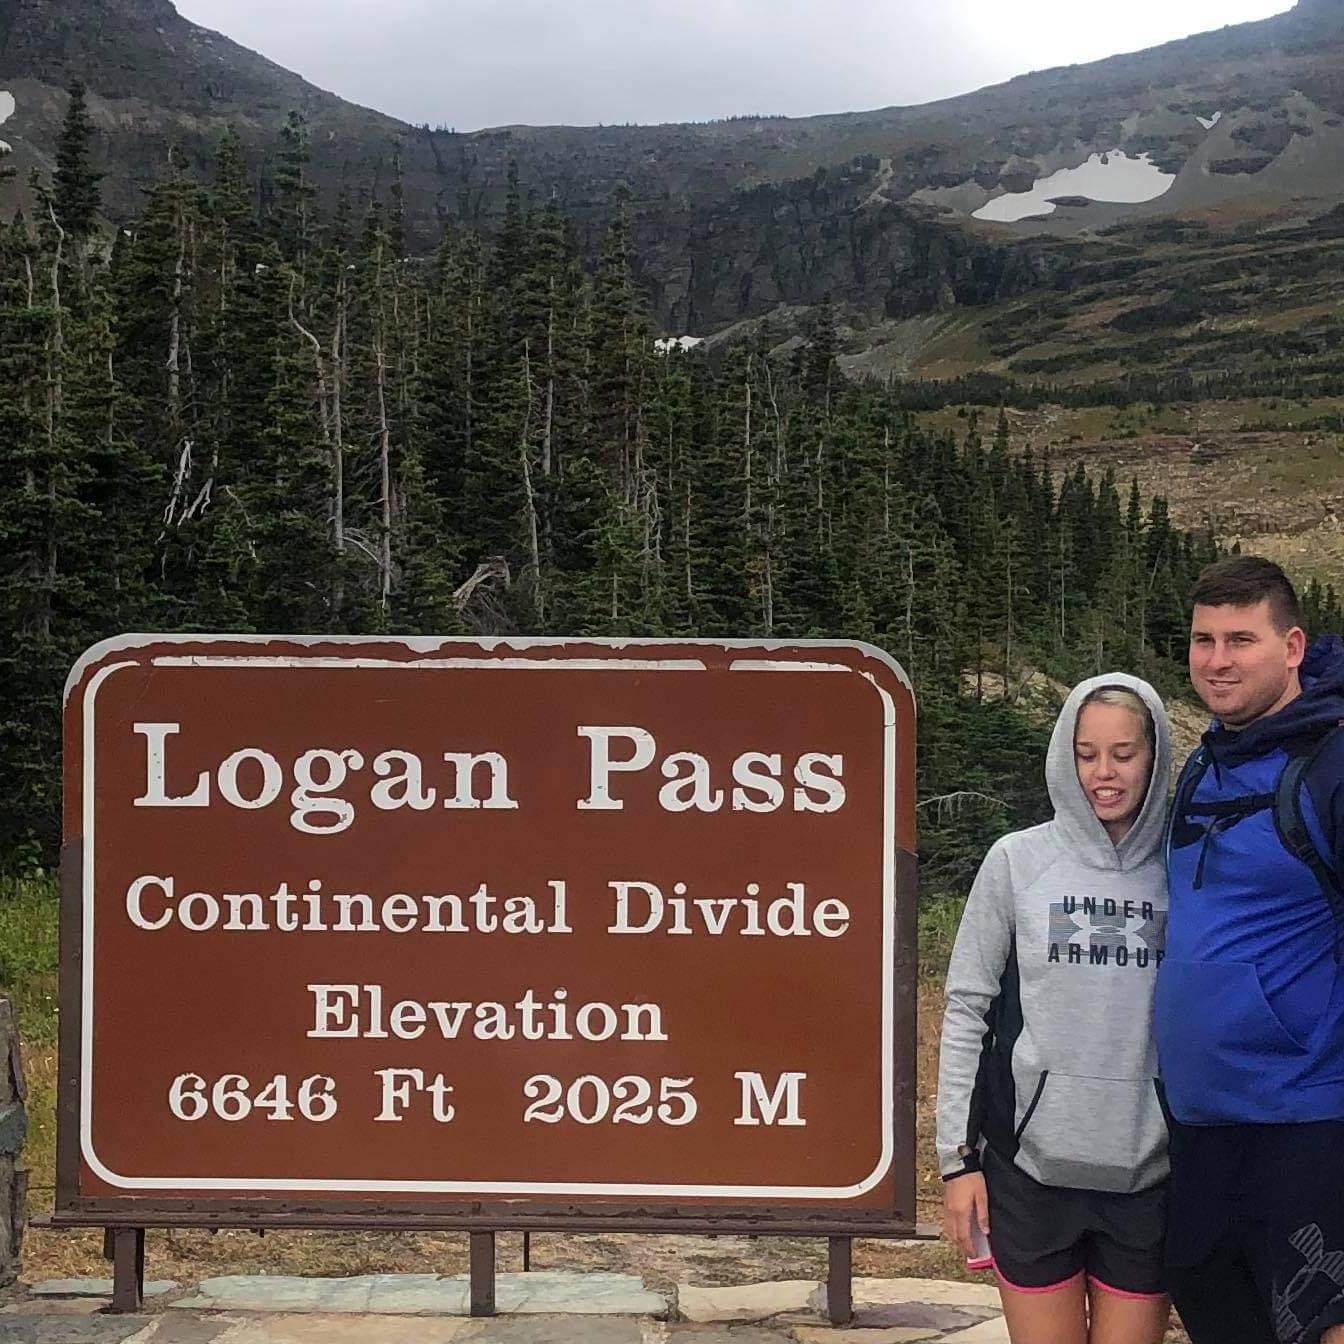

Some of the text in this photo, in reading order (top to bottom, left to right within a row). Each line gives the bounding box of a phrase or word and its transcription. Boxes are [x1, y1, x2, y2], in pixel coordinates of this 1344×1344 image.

[134, 723, 847, 834] Logan Pass
[126, 876, 850, 938] Continental Divide
[1063, 895, 1154, 921] UNDER
[306, 984, 668, 1041] Elevation
[168, 1067, 807, 1126] 6646 Ft 2025 M
